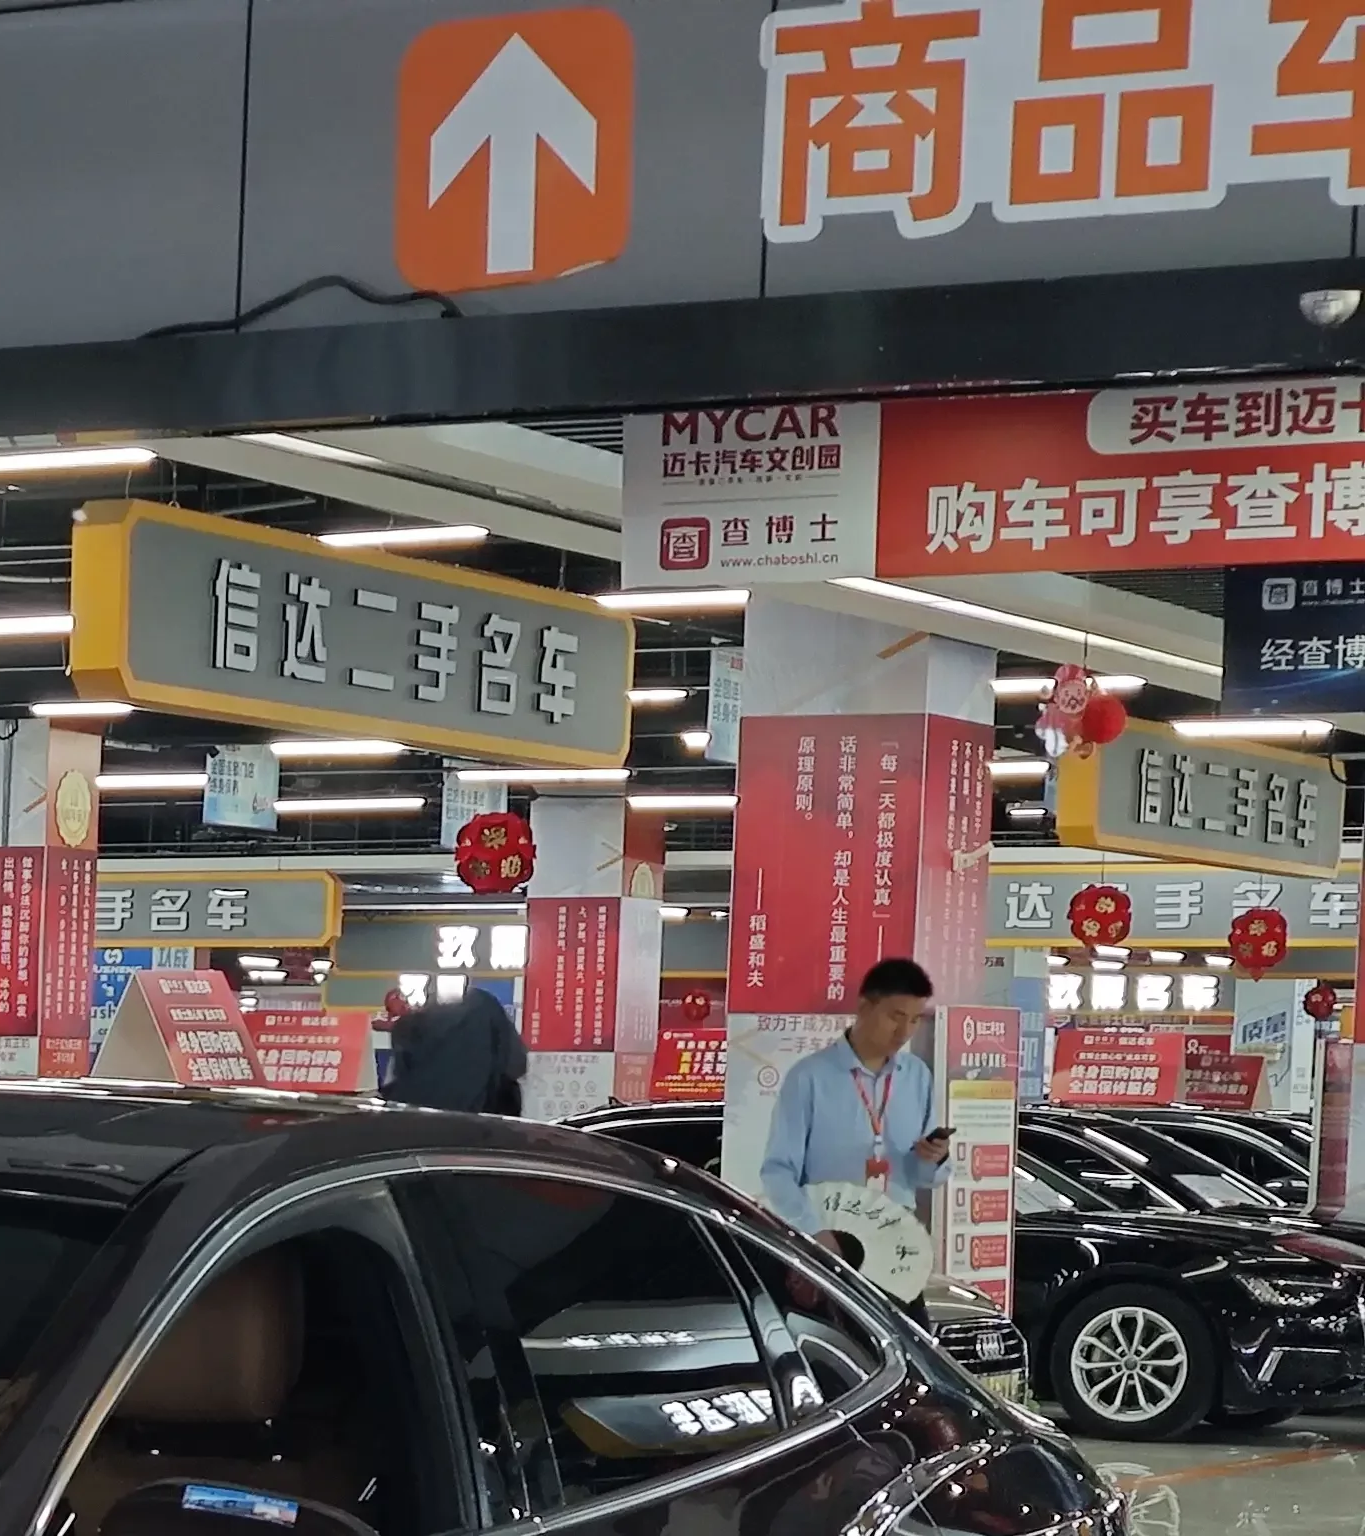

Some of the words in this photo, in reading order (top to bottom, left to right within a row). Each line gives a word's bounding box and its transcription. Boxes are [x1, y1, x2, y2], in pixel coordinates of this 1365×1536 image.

[661, 403, 840, 446] MYCAR
[662, 444, 841, 478] 迈卡汽车文创园
[720, 513, 839, 547] 查博士
[925, 461, 1365, 555] 购车可享查博
[212, 556, 581, 726] 信达二手名车
[1260, 634, 1365, 672] 经查博
[795, 736, 817, 821] 原理原则。
[1137, 747, 1319, 848] 信达二手名车
[827, 735, 858, 1001] 话非常简单，却是人生最重要的
[1004, 881, 1360, 930] 达手名车
